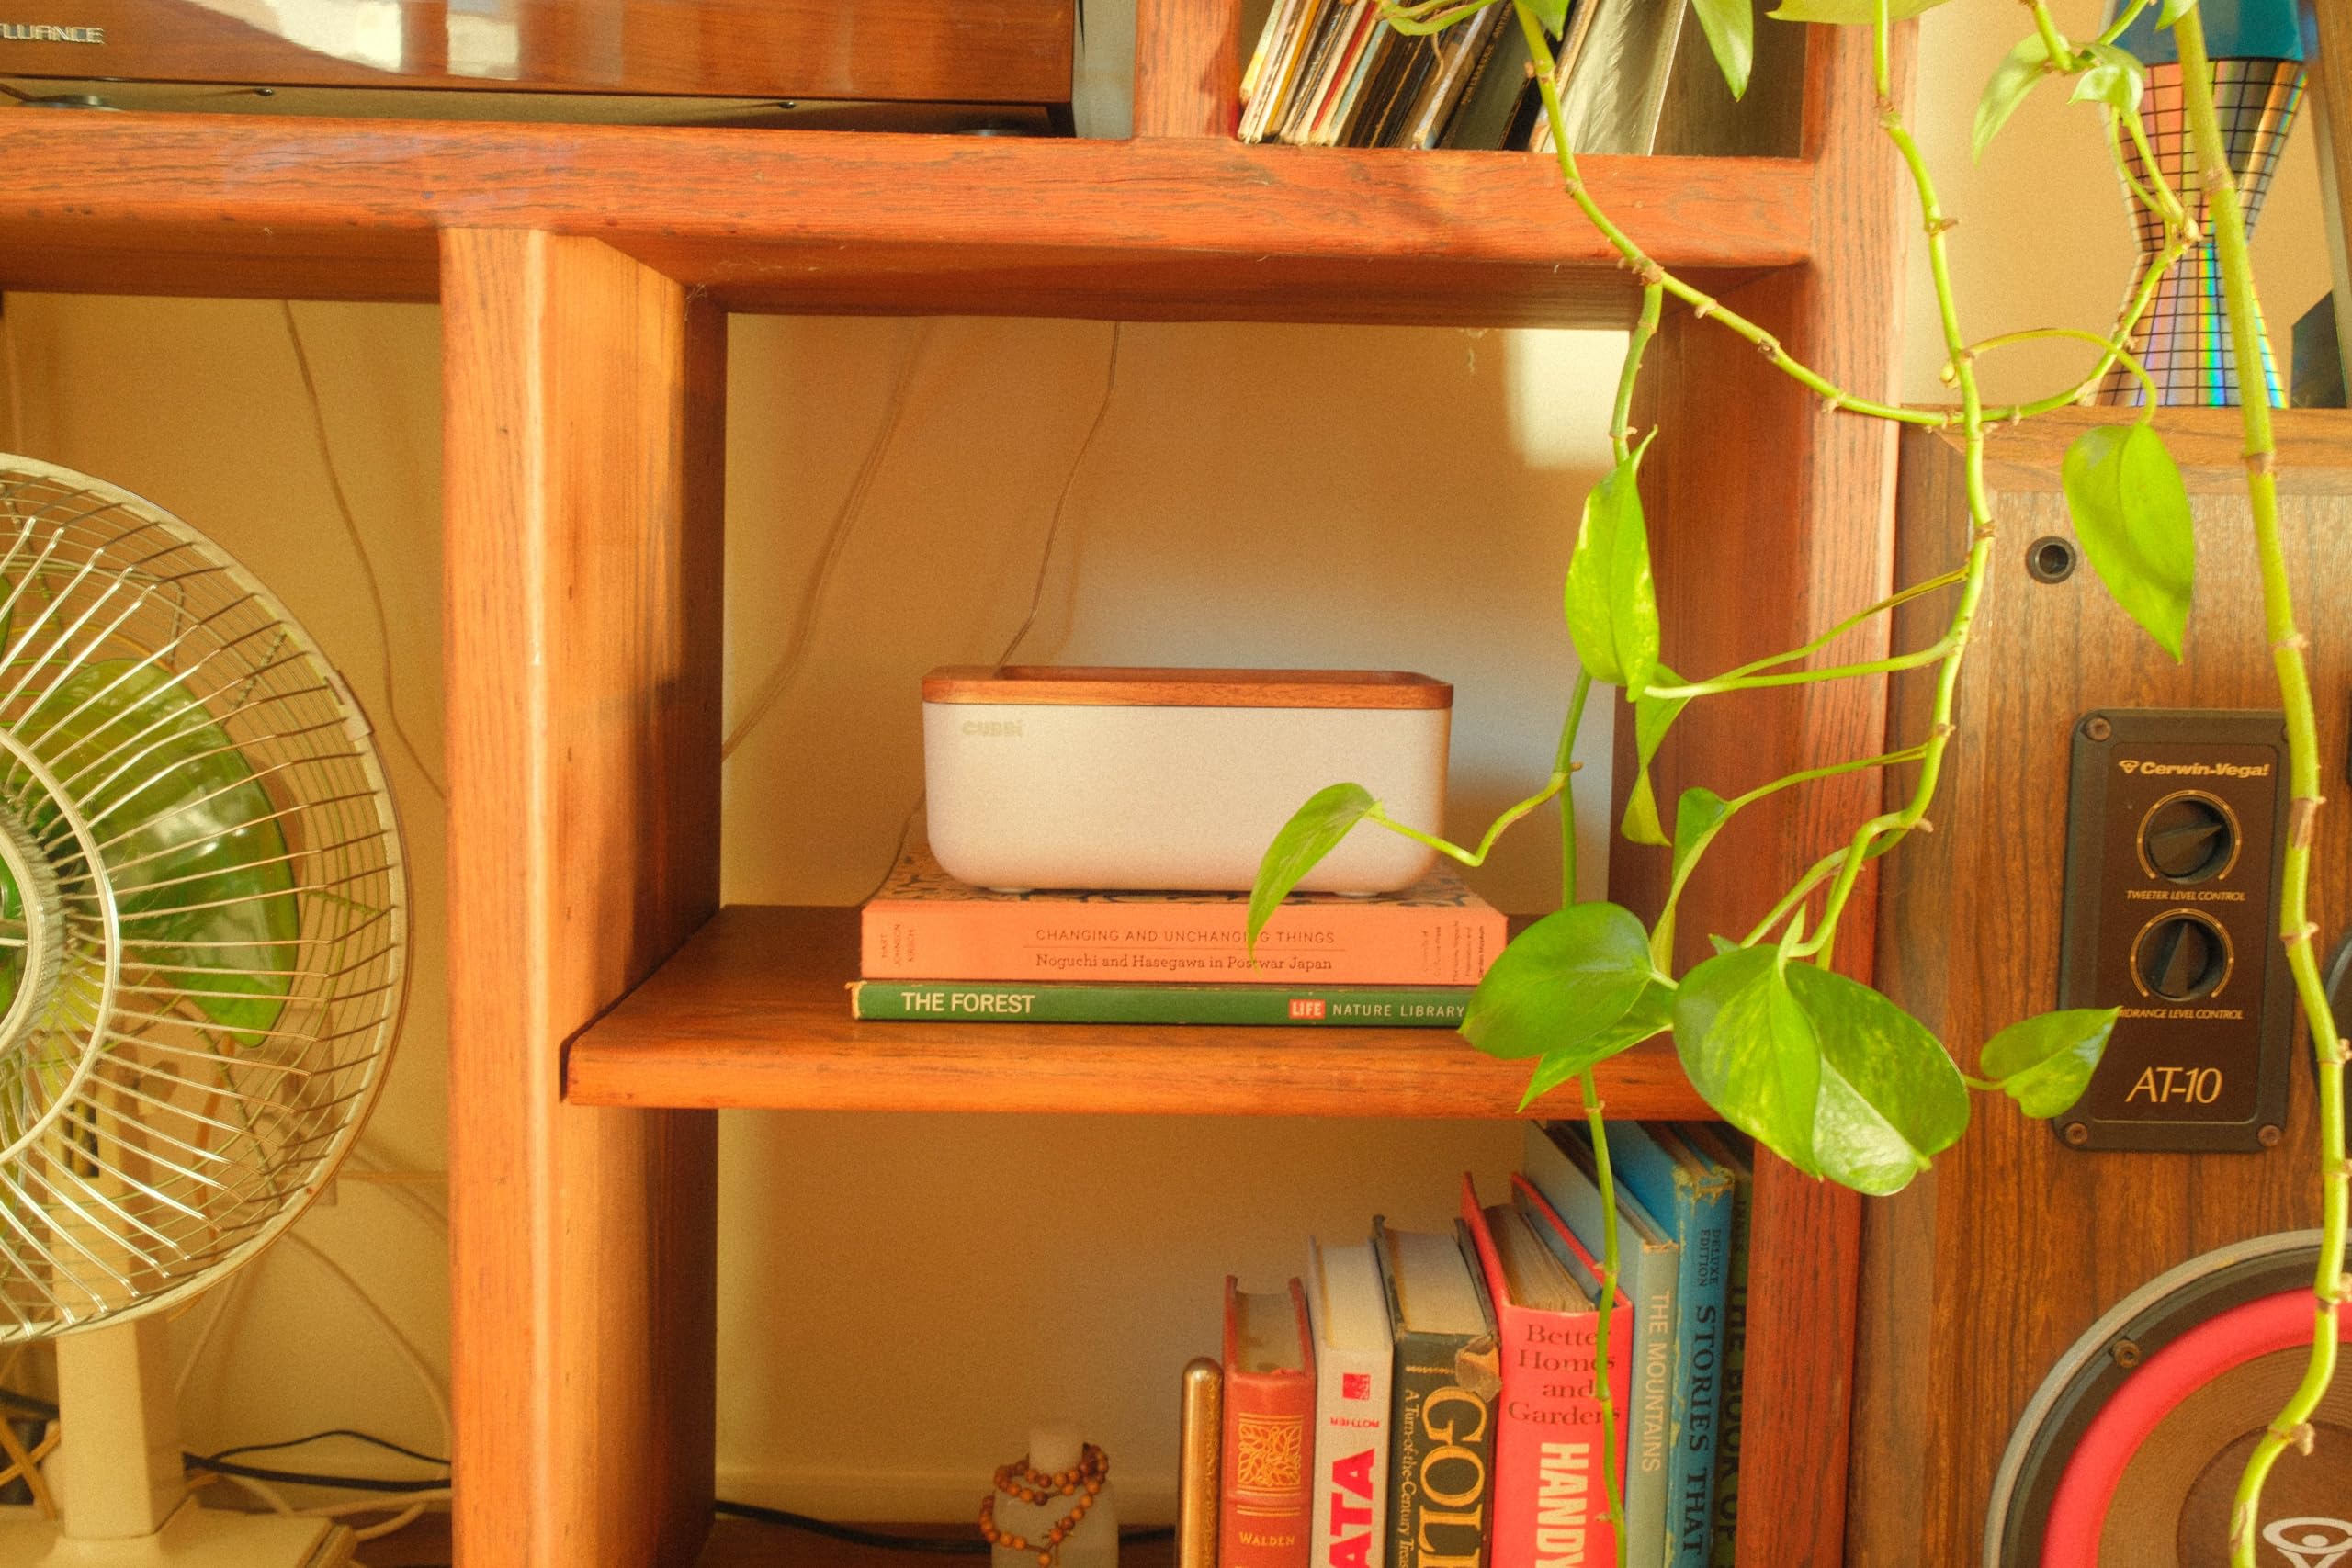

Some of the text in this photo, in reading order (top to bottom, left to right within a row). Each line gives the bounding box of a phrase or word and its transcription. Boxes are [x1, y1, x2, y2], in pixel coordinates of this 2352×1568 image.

[0, 23, 104, 44] LUANCE
[2140, 761, 2271, 779] Cerwin-Vega!
[2126, 890, 2245, 901] TWEETER LEVEL CONTROL
[1035, 929, 1335, 944] CHANGING AND UNCHANGIG THINGS
[1035, 953, 1098, 970] Noguchi
[1102, 953, 1128, 967] and
[1131, 954, 1205, 971] Hasegawa
[1209, 956, 1223, 969] in
[1289, 956, 1332, 973] Japan
[900, 991, 1035, 1013] THE FOREST
[1292, 1000, 1323, 1017] LIFE
[1332, 1003, 1465, 1018] NATURE LIBRARY
[2168, 1009, 2196, 1019] LEVEL
[2196, 1010, 2245, 1020] CONTROL
[2124, 1066, 2223, 1104] AT-10
[1527, 1324, 1611, 1346] Bette
[1543, 1379, 1594, 1397] and
[1641, 1289, 1671, 1472] THE MOUNTAINS
[1405, 1388, 1421, 1401] A
[1682, 1304, 1717, 1552] STORIES THAT
[1398, 1404, 1419, 1536] Turn-of-the-Century
[1535, 1442, 1590, 1568] HAND
[1238, 1531, 1295, 1547] WALDEN
